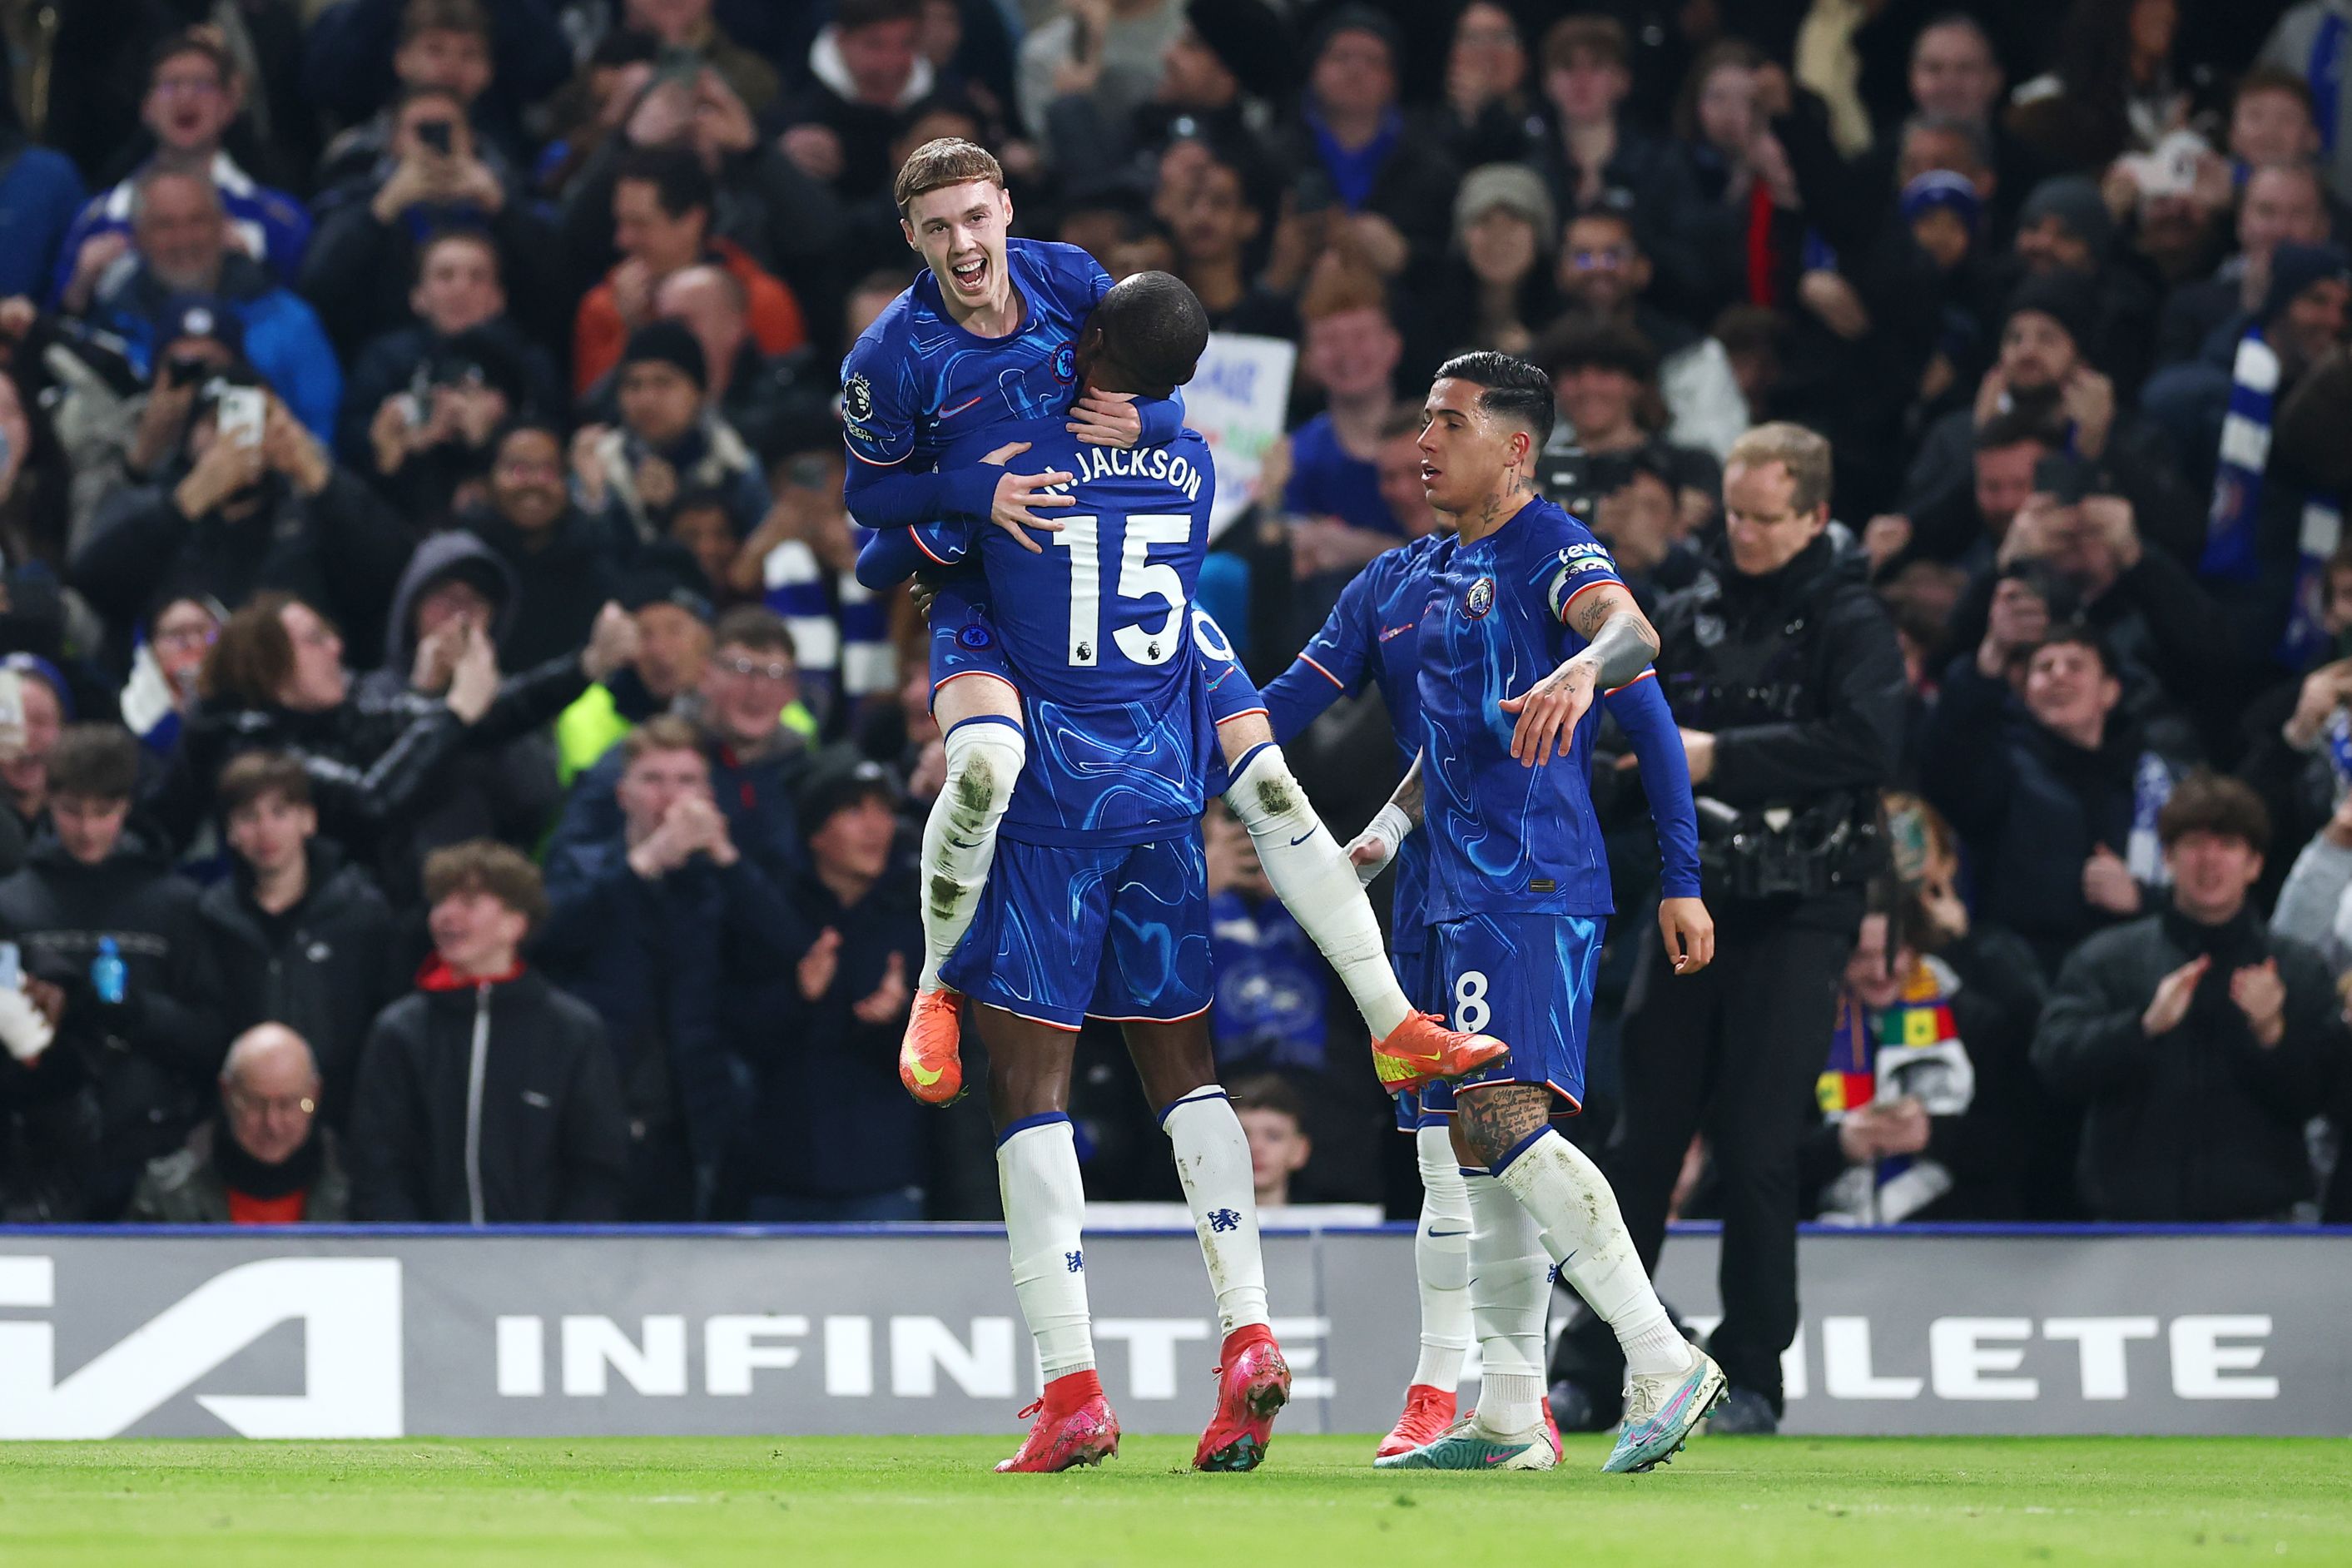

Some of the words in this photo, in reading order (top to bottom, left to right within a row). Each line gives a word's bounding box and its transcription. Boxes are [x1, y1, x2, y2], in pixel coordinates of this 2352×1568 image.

[1053, 514, 1192, 667] 15
[1191, 610, 1235, 671] 0
[1455, 970, 1491, 1035] 8
[496, 1313, 1336, 1401] INFINTE
[1458, 1313, 2280, 1401] LETE
